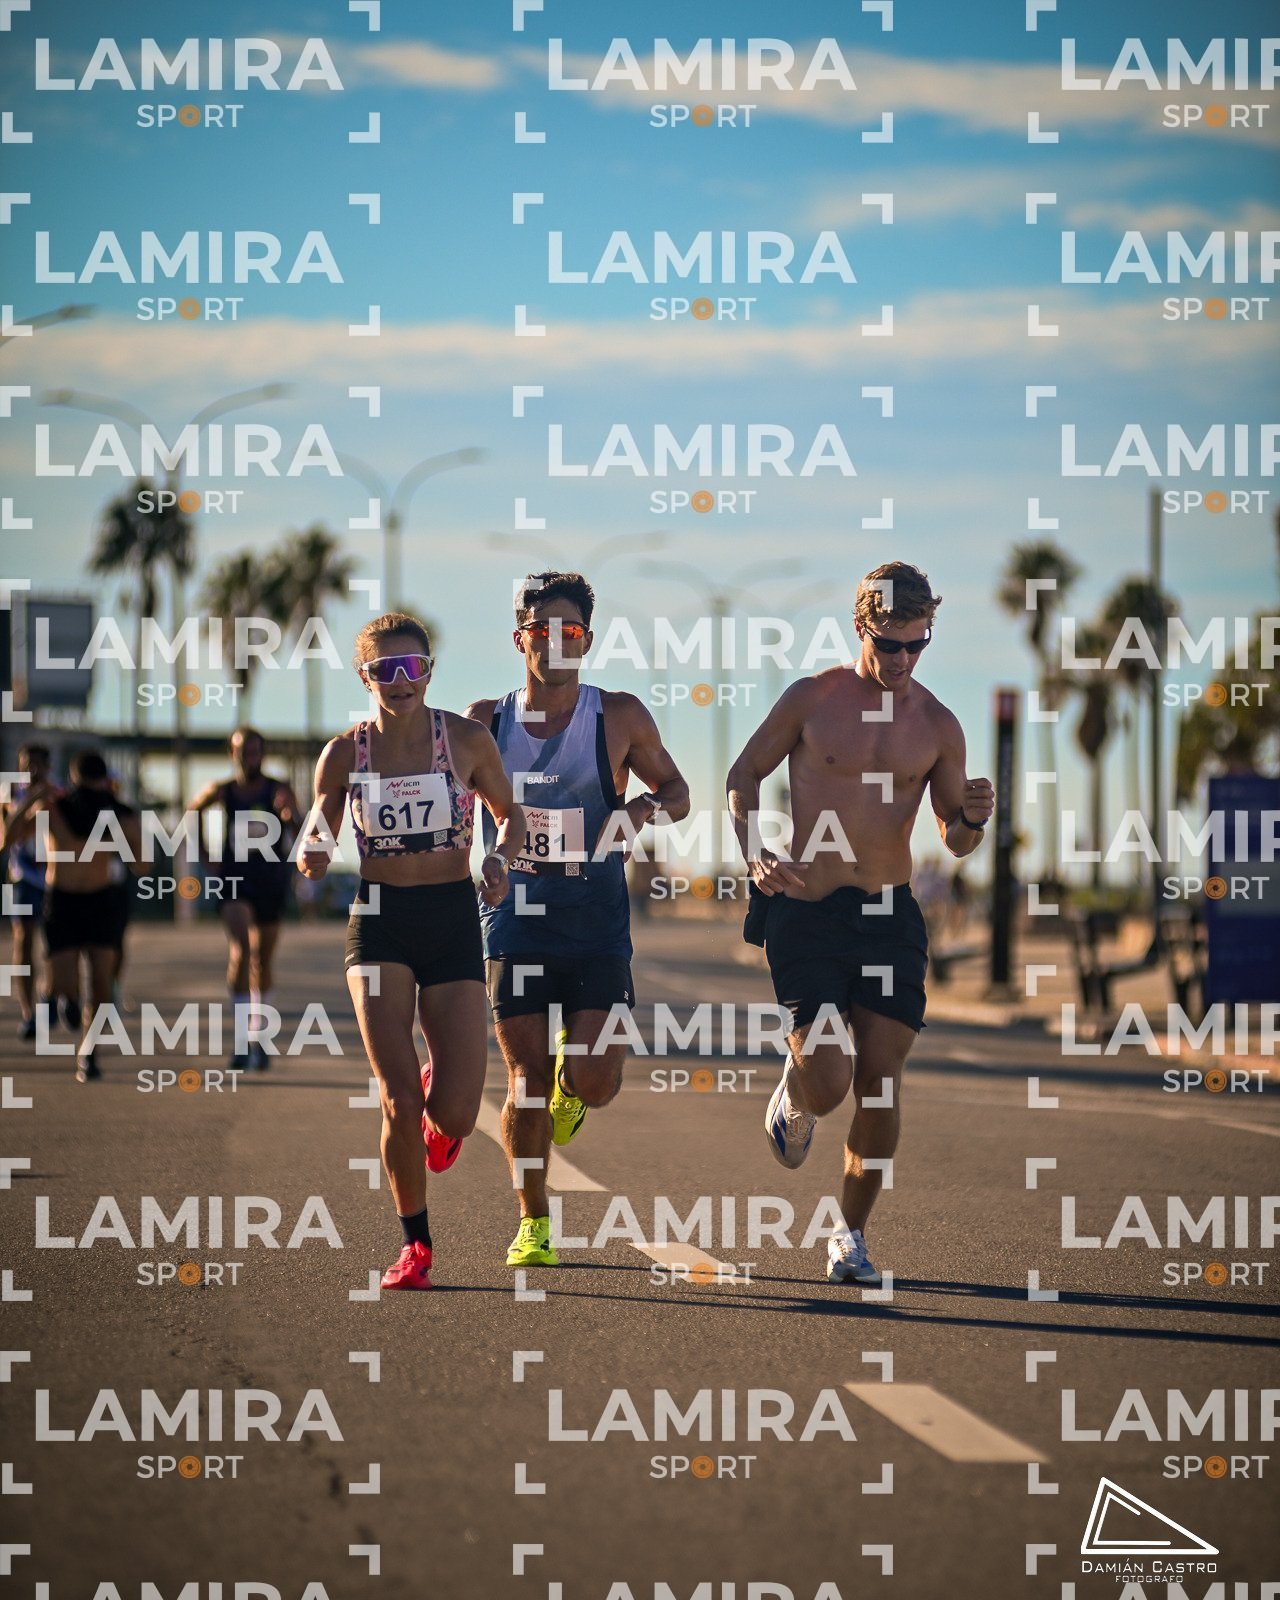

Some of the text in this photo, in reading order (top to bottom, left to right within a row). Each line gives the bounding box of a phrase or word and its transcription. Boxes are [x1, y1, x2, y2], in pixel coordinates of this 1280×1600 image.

[526, 775, 560, 784] BANDIT
[378, 800, 435, 831] 617
[373, 836, 402, 850] 30K
[523, 831, 566, 858] 481
[509, 858, 535, 871] 30K
